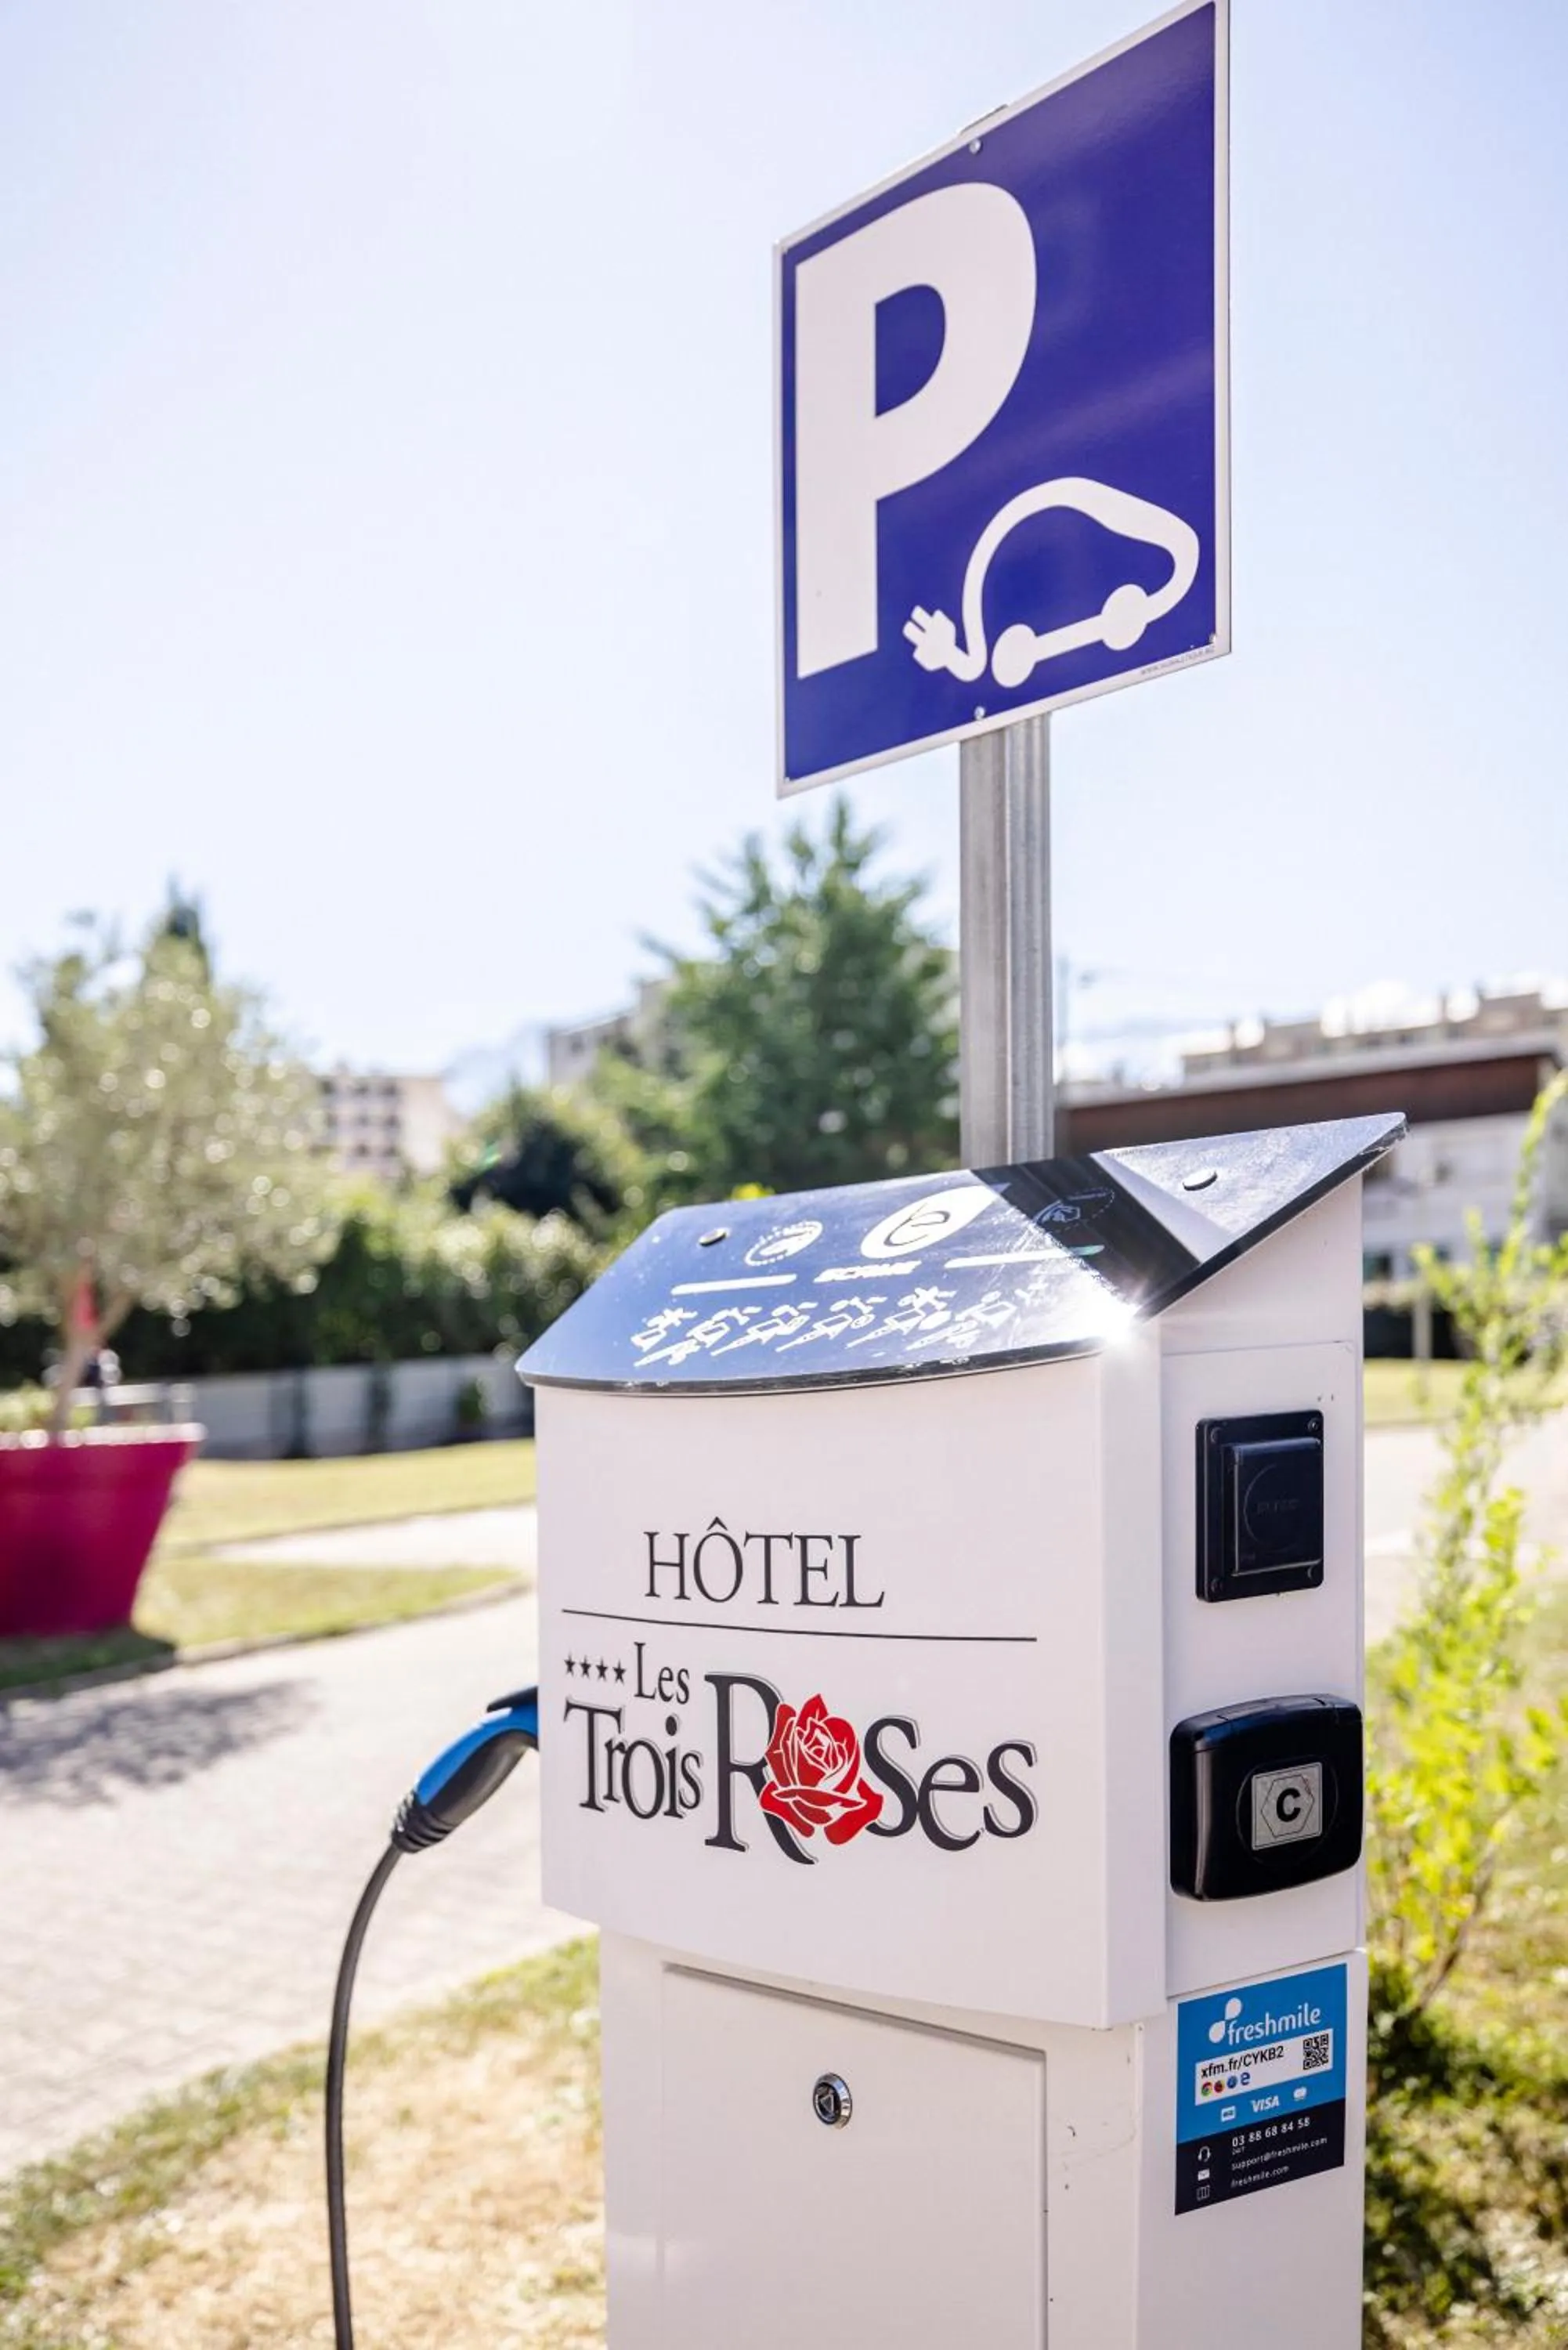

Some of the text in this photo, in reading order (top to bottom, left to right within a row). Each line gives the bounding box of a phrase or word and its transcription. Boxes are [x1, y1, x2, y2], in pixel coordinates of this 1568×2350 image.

[795, 182, 1037, 679] P
[644, 1517, 885, 1608] HÔTEL
[634, 1641, 690, 1705] Les
[563, 1672, 1039, 1866] Trois Rses
[1276, 1788, 1301, 1822] C
[1227, 2002, 1321, 2046] freshmile
[1200, 2045, 1284, 2079] xfm.fr/CYKB2
[1251, 2095, 1280, 2113] VISA
[1232, 2135, 1245, 2147] 03
[1248, 2131, 1262, 2142] 88
[1265, 2125, 1278, 2138] 68
